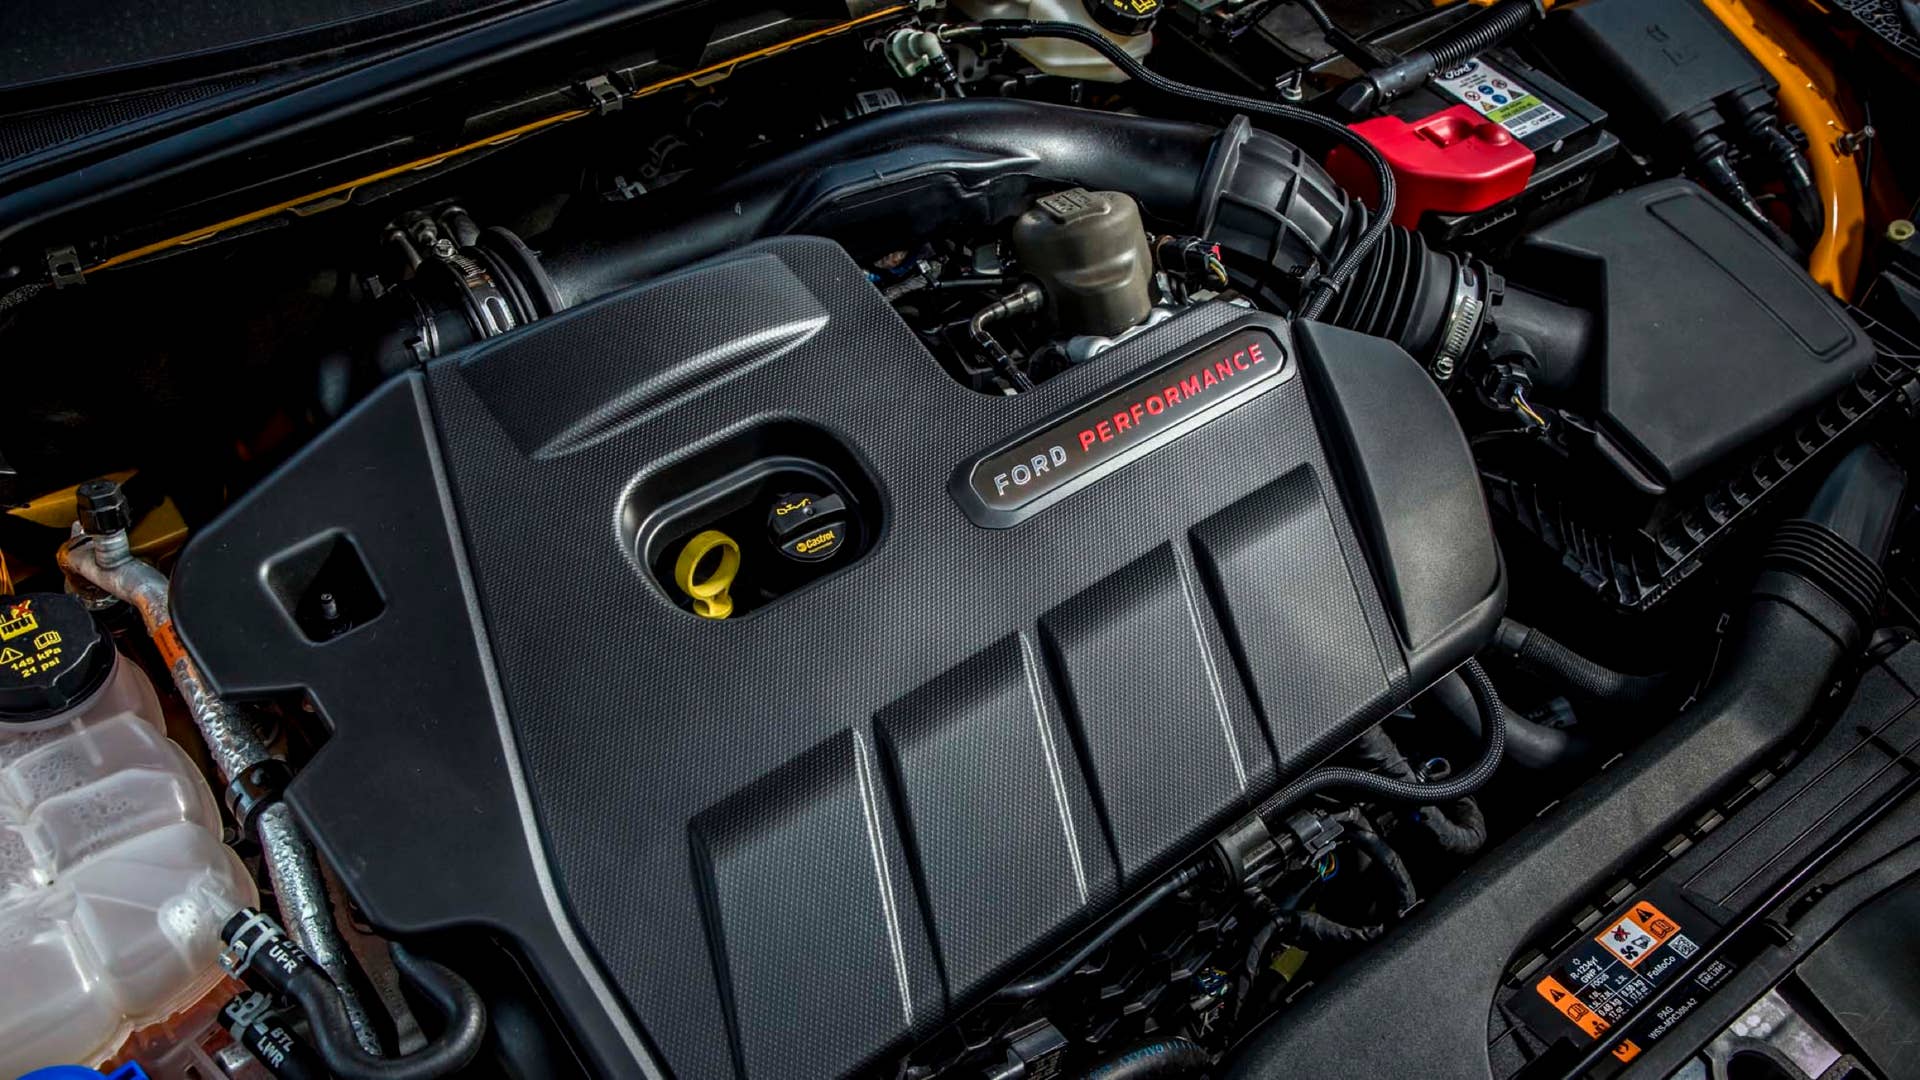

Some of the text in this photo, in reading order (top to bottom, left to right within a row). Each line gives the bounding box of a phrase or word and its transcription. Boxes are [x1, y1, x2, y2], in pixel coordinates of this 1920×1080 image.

[994, 343, 1266, 496] FORD PERFORMANCE
[806, 530, 835, 548] Castrol
[10, 647, 62, 671] 145 kPa
[21, 657, 60, 678] 21 psi
[268, 944, 298, 975] UPR
[1647, 956, 1676, 979] FoMoCo
[1580, 968, 1597, 984] GWP
[1590, 973, 1610, 989] FOCUS
[1657, 1005, 1674, 1020] PAG
[270, 1027, 295, 1052] BTL
[256, 1035, 284, 1069] LWR
